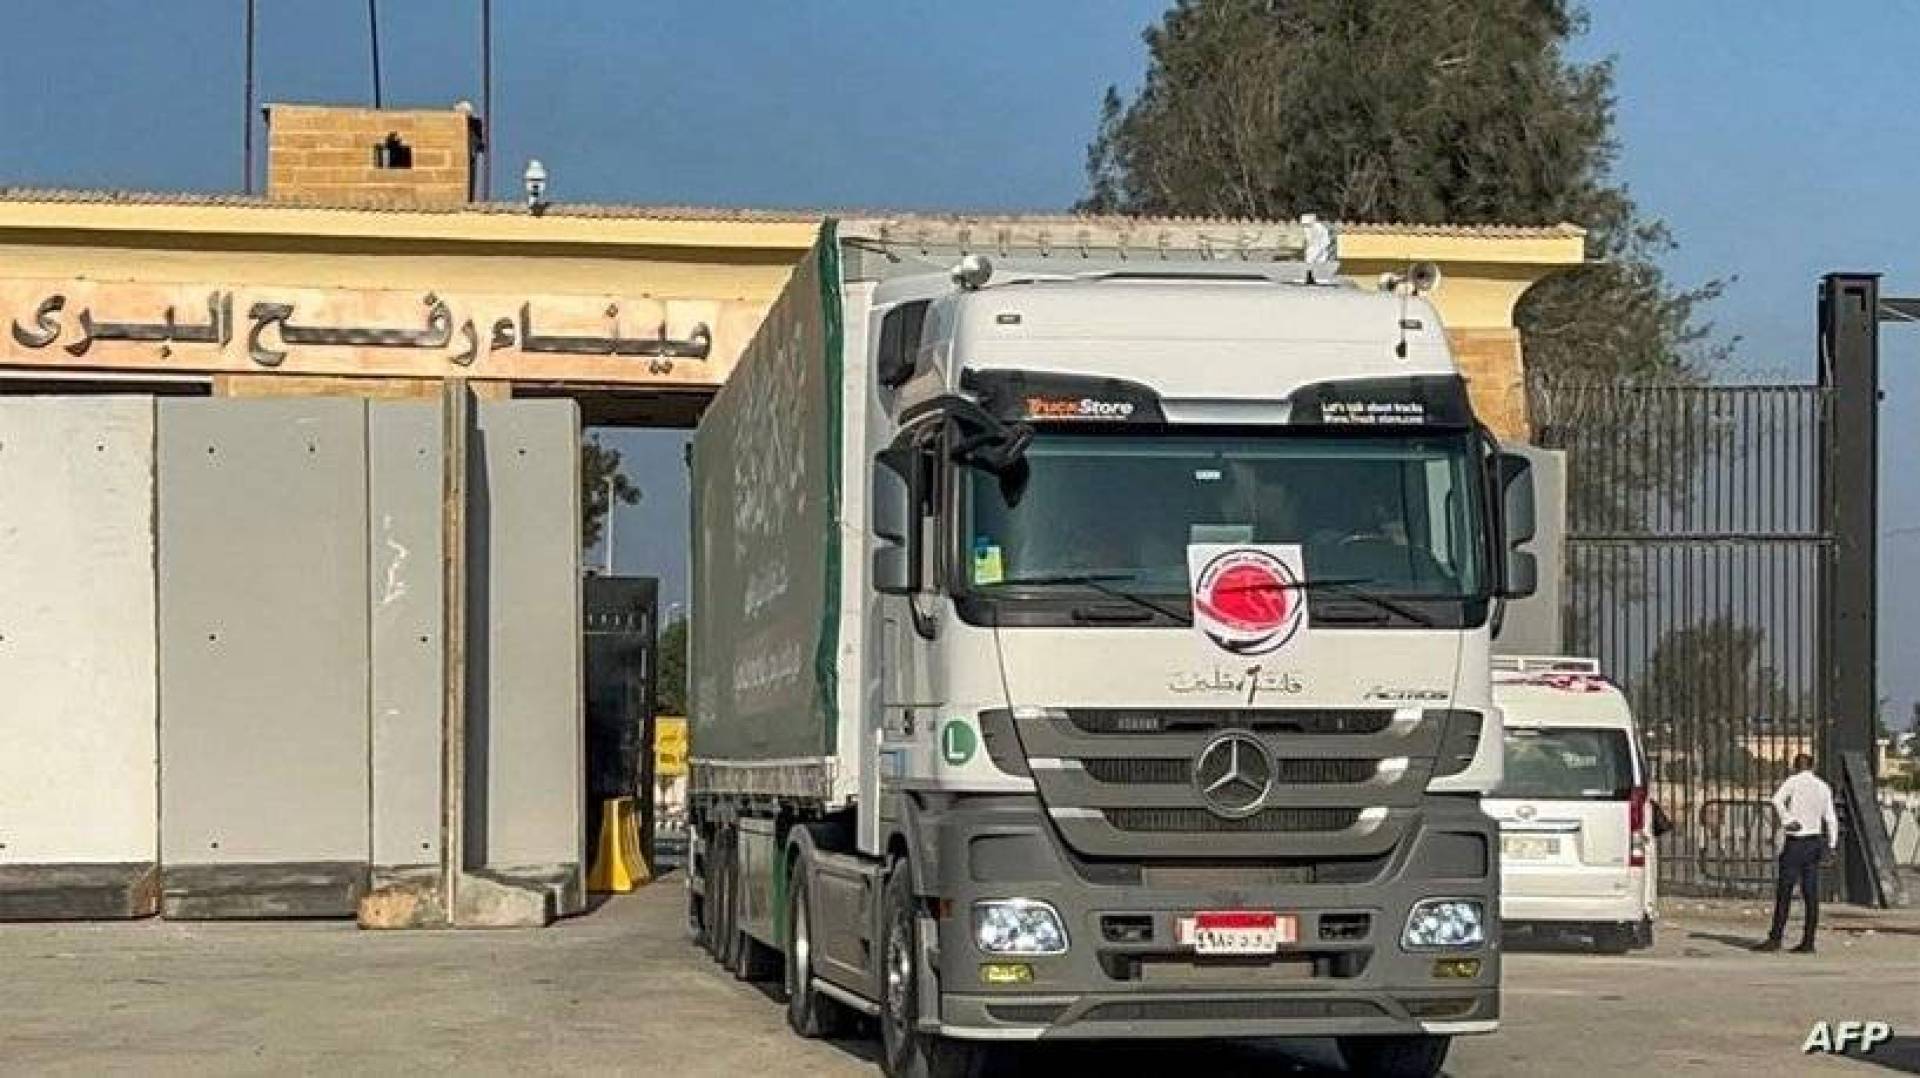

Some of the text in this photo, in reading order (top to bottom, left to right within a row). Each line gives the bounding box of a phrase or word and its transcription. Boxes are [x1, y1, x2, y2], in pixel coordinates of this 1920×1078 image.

[248, 290, 478, 367] رفح
[490, 299, 712, 376] ميناء
[947, 726, 967, 760] L
